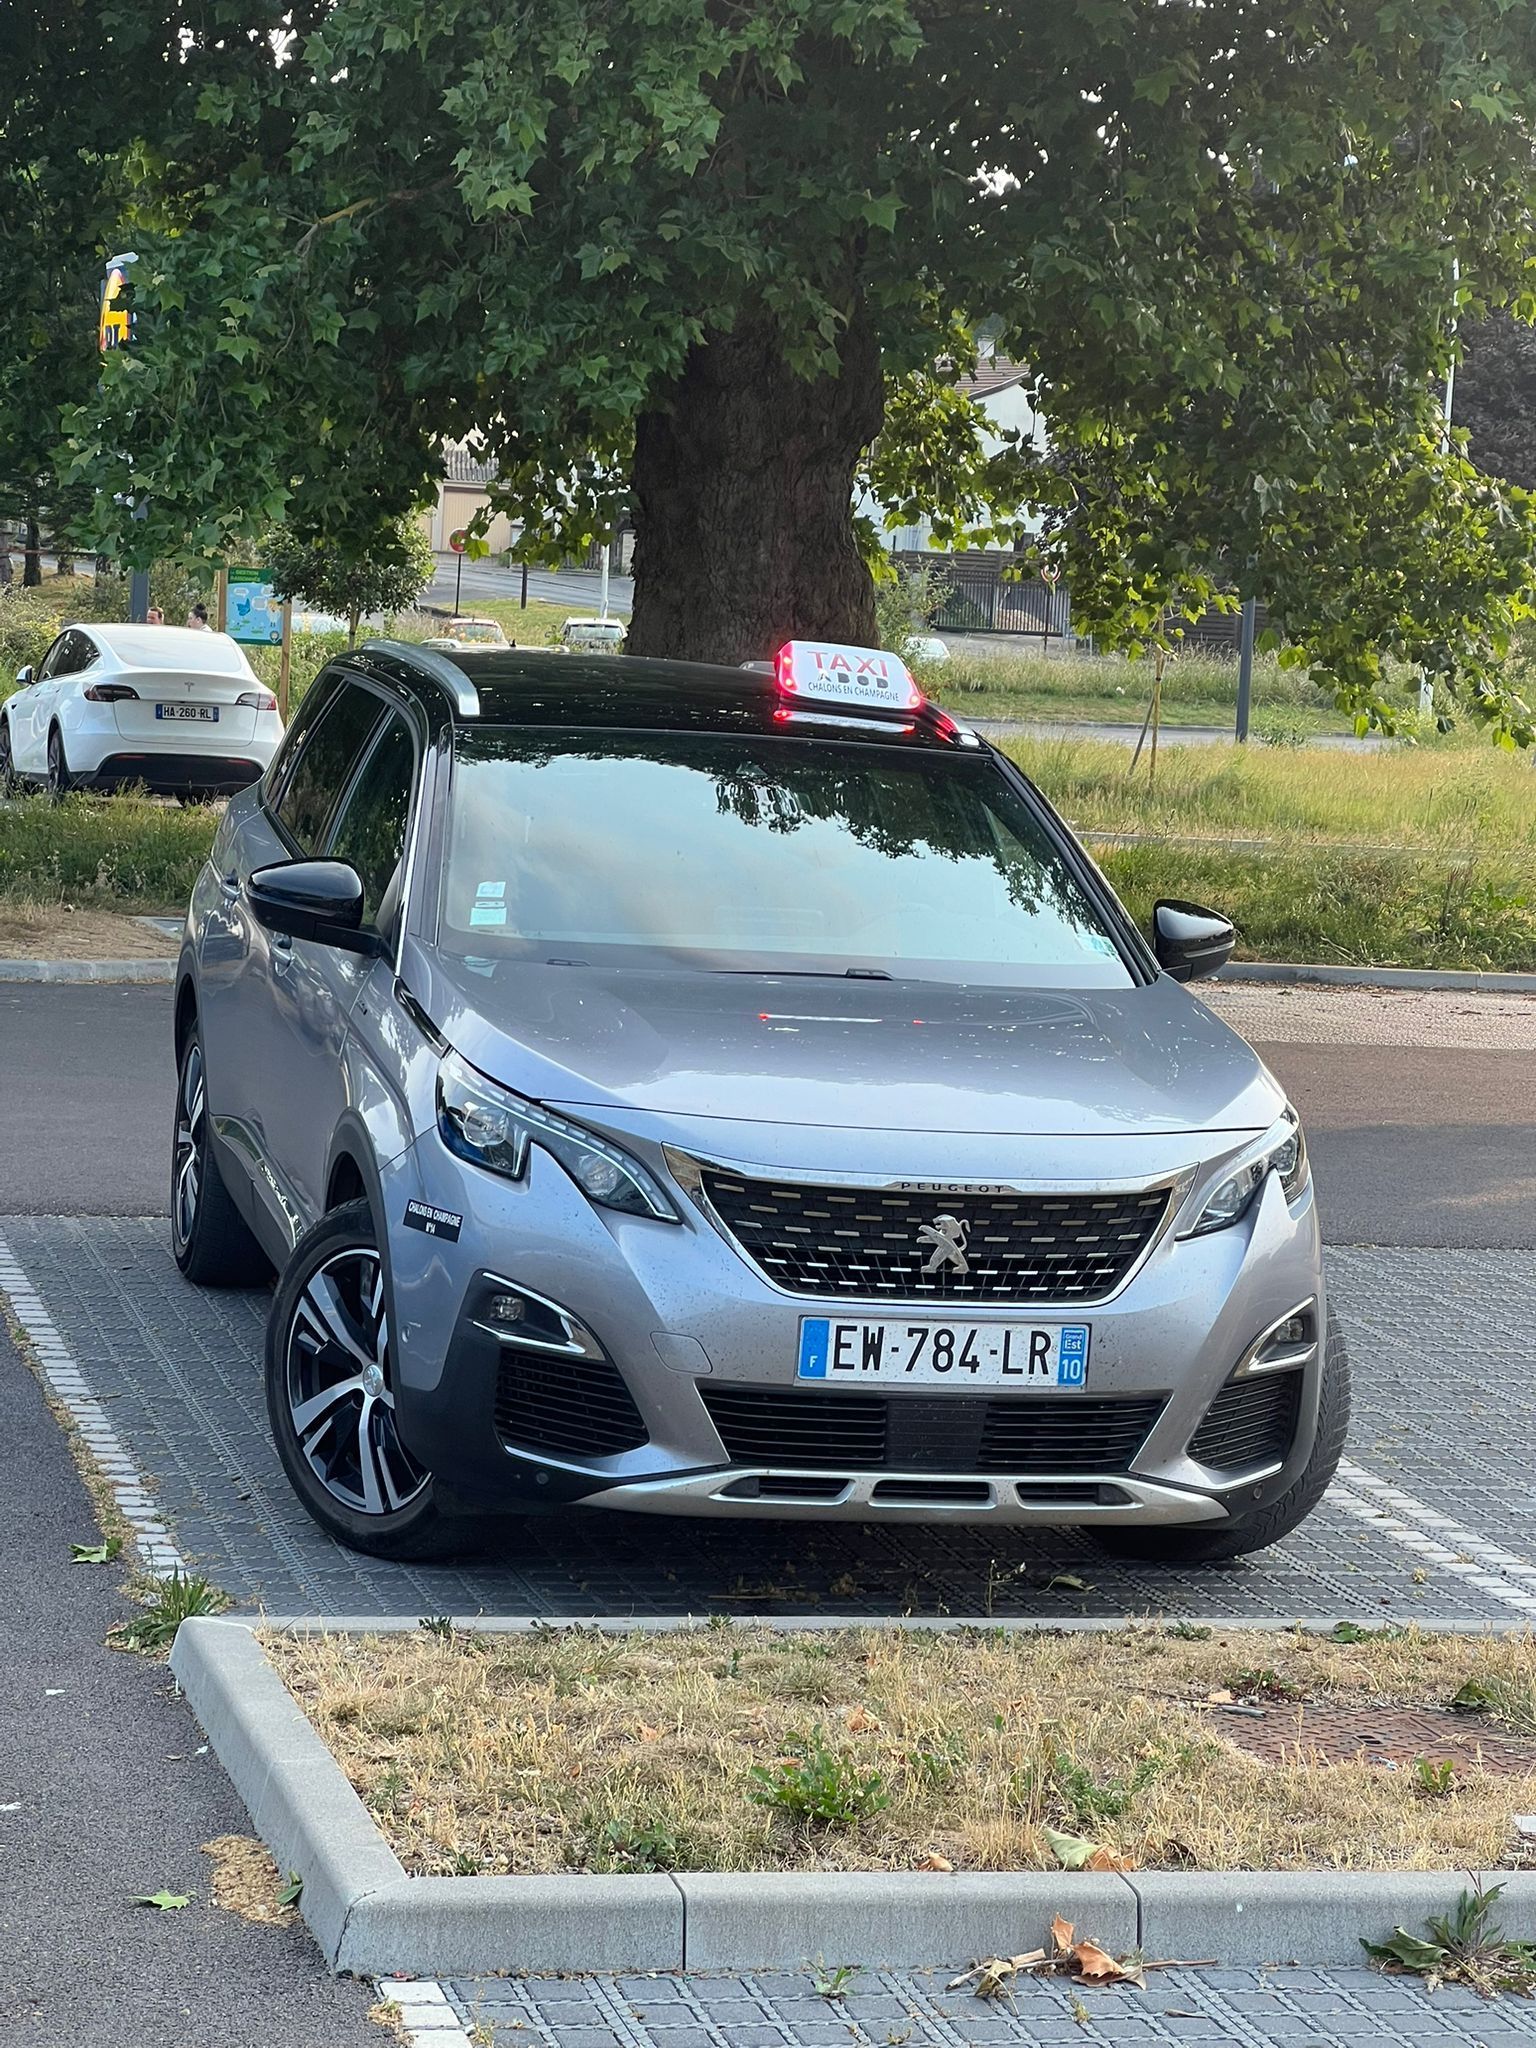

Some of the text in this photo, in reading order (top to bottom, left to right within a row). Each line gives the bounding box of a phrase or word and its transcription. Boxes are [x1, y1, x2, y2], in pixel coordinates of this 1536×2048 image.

[807, 651, 888, 677] TAXI
[808, 682, 900, 701] CHALONS EN CHAMPAGNE
[901, 1182, 1005, 1193] PEUGEOT
[832, 1324, 1052, 1376] EW-784-LR
[1064, 1339, 1082, 1350] Est
[808, 1355, 818, 1368] F
[1061, 1358, 1081, 1380] 10
